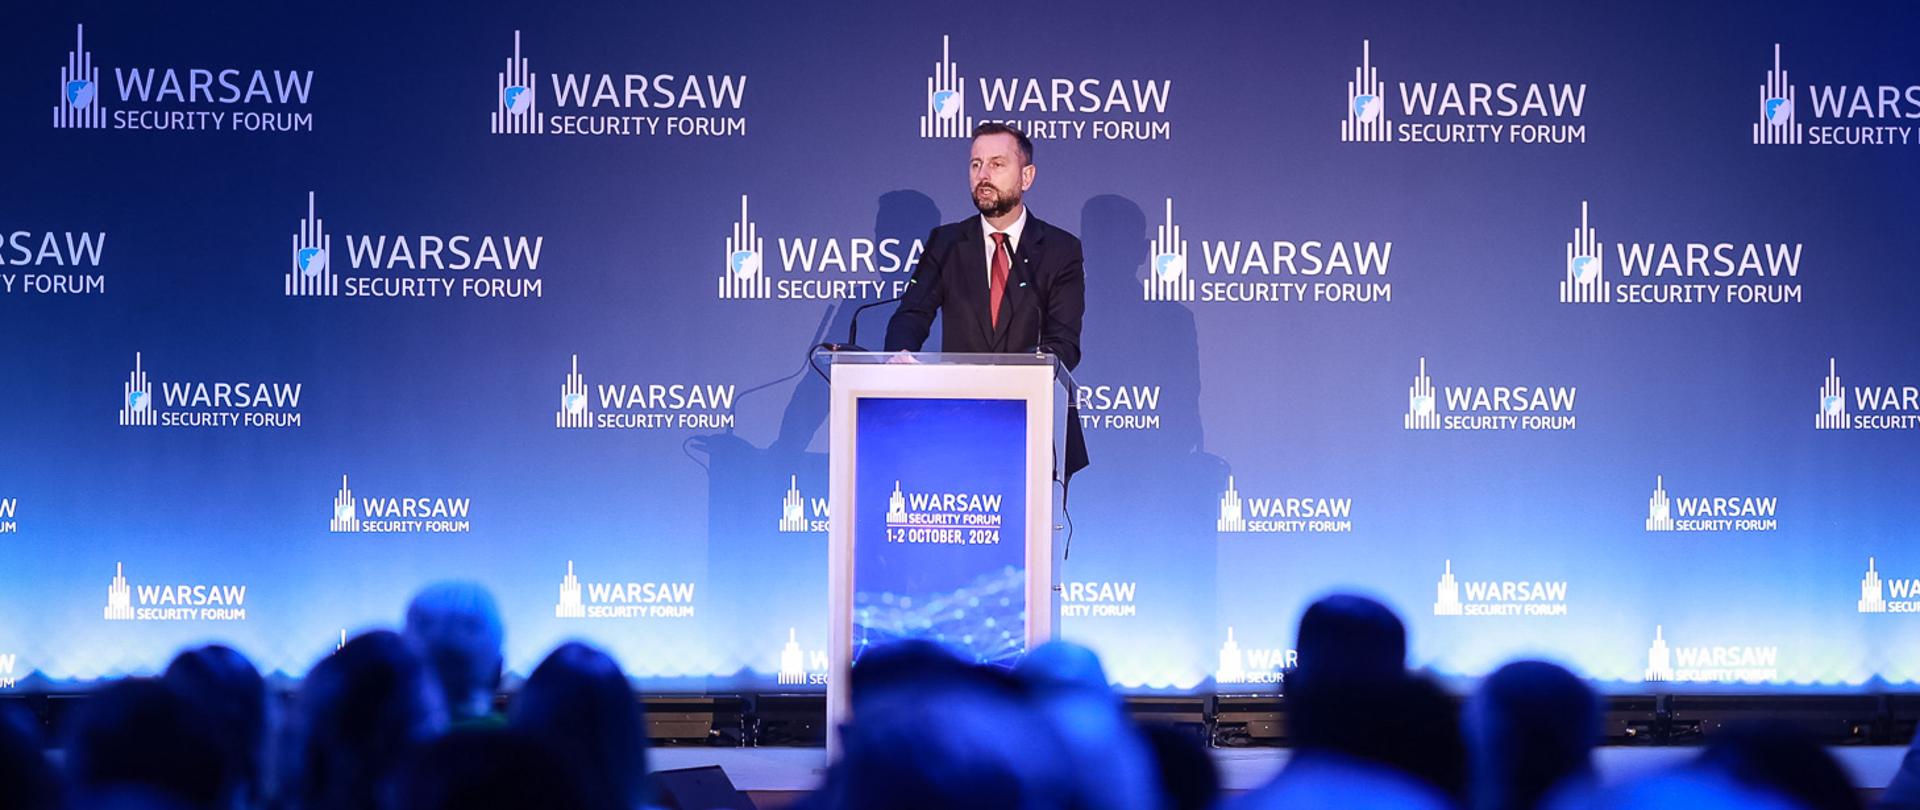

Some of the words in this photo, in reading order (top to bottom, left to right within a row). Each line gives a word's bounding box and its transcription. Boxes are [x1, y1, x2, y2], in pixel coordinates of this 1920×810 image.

[115, 68, 313, 104] WARSAW
[551, 74, 747, 109] WARSAW
[980, 78, 1170, 113] WARSAW
[1400, 83, 1587, 117] WARSAW
[113, 110, 225, 132] SECURITY
[232, 110, 313, 132] FORUM
[550, 115, 660, 136] SECURITY
[667, 115, 746, 136] FORUM
[978, 120, 1085, 139] URITY
[1092, 120, 1170, 140] FORUM
[1398, 123, 1503, 144] SECURITY
[1510, 123, 1586, 144] FORUM
[1809, 126, 1912, 145] SECURITY
[346, 236, 543, 270] WARSAW
[1201, 241, 1392, 275] WARSAW
[1617, 244, 1802, 277] WARSAW
[24, 273, 105, 294] FORUM
[345, 277, 455, 298] SECURITY
[462, 277, 542, 298] FORUM
[777, 280, 886, 299] SECURITY
[1201, 282, 1308, 302] SECURITY
[1314, 282, 1391, 302] FORUM
[1616, 284, 1720, 303] SECURITY
[1727, 284, 1802, 303] FORUM
[163, 383, 301, 407] WARSAW
[598, 385, 734, 409] WARSAW
[1445, 387, 1576, 411] WARSAW
[1854, 387, 1920, 411] WAR
[161, 412, 239, 427] SECURITY
[244, 412, 301, 427] FORUM
[597, 413, 674, 428] SECURITY
[678, 413, 734, 428] FORUM
[1105, 415, 1160, 429] FORUM
[1444, 416, 1517, 430] SECURITY
[1522, 416, 1576, 430] FORUM
[363, 498, 470, 517] WARSAW
[909, 494, 1001, 512] WARSAW
[1249, 498, 1352, 517] WARSAW
[1676, 498, 1777, 517] WARSAW
[362, 520, 423, 533] SECURITY
[425, 520, 470, 533] FORUM
[908, 513, 959, 525] SECURITY
[962, 513, 1001, 525] FORUM
[1248, 520, 1306, 532] SECURITY
[1309, 520, 1352, 532] FORUM
[1676, 519, 1732, 531] SECURITY
[1735, 519, 1777, 531] FORUM
[886, 529, 905, 543] 1-2
[909, 529, 966, 545] OCTOBER,
[969, 530, 1000, 544] 2024
[137, 586, 246, 605] WARSAW
[588, 583, 695, 603] WARSAW
[1465, 582, 1567, 601] WARSAW
[137, 608, 197, 620] SECURITY
[200, 608, 246, 620] FORUM
[587, 605, 647, 618] SECURITY
[650, 605, 694, 618] FORUM
[1092, 605, 1136, 617] FORUM
[1464, 603, 1522, 616] SECURITY
[1524, 603, 1567, 616] FORUM
[1676, 646, 1777, 666] WARSAW
[1675, 669, 1732, 681] SECURITY
[1735, 669, 1777, 681] FORUM
